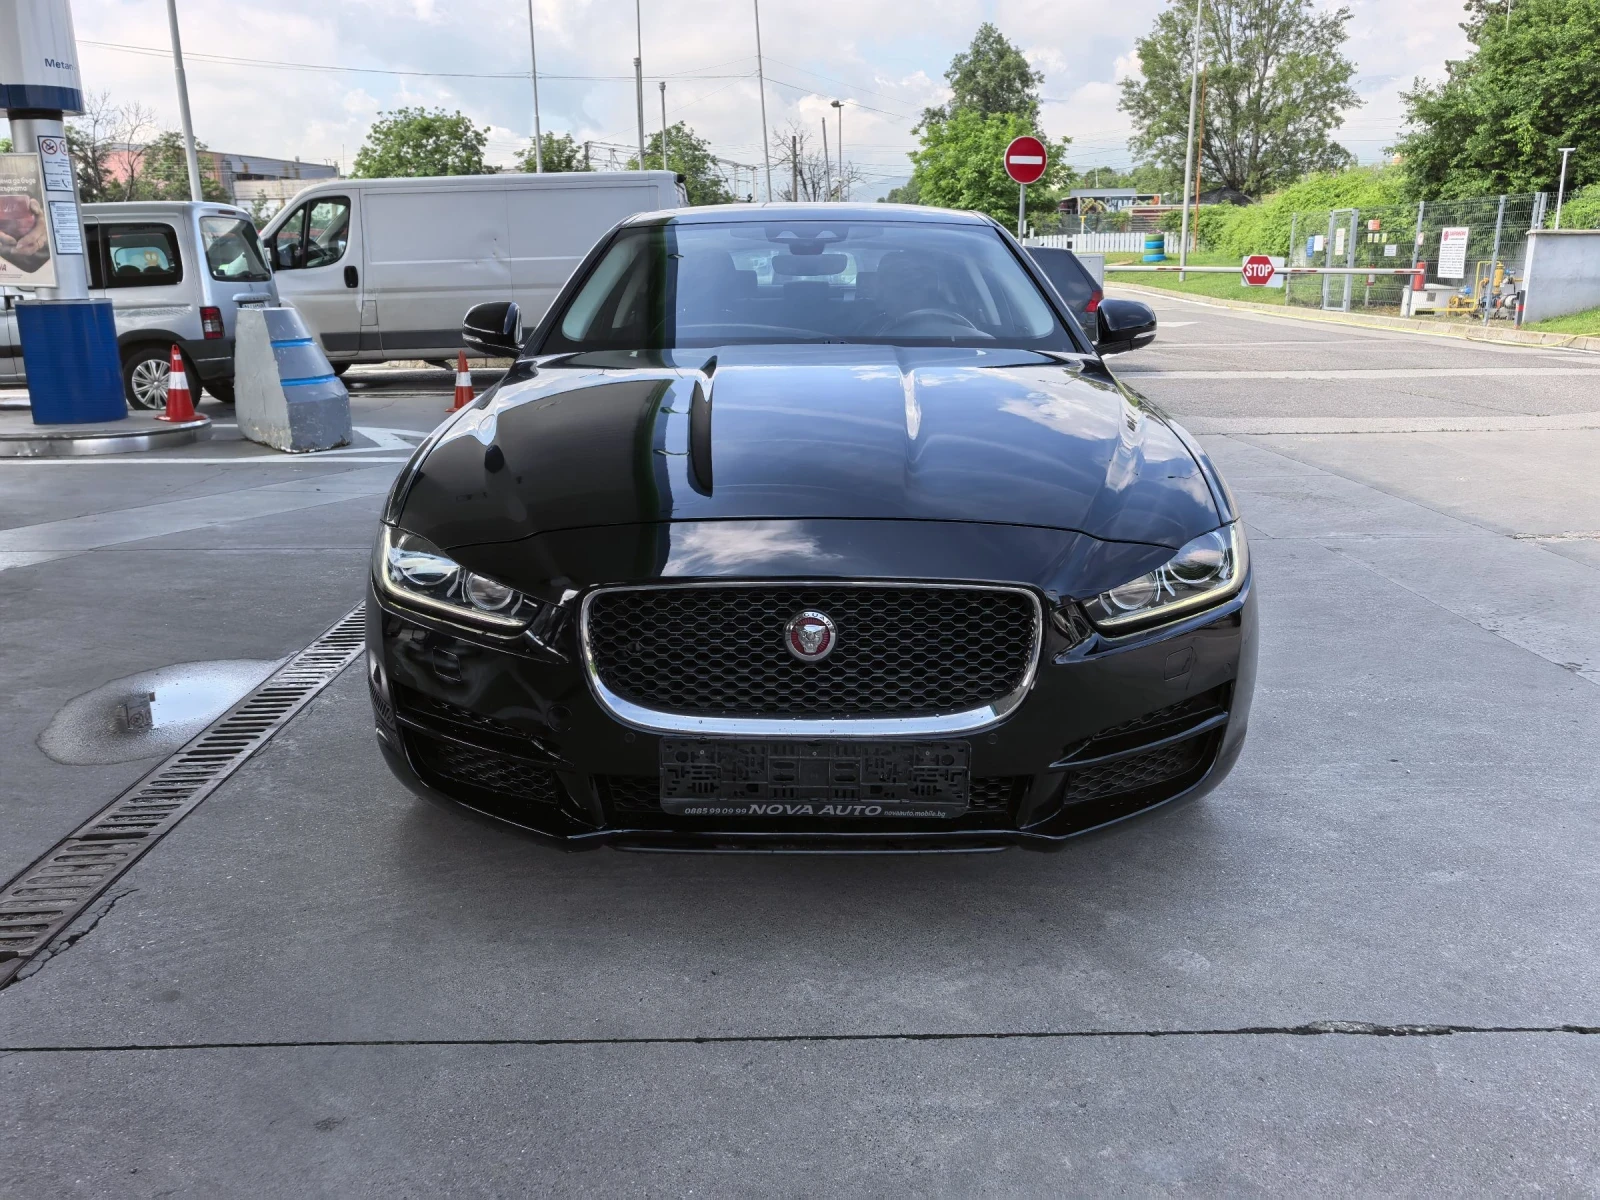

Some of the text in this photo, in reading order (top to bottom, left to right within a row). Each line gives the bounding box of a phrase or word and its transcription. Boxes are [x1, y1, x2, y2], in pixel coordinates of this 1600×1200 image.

[1246, 264, 1271, 276] STOP
[684, 807, 708, 815] 0885
[709, 807, 721, 815] 99
[722, 807, 734, 815] 09
[735, 807, 747, 815] 99
[748, 804, 814, 815] NOVA
[818, 804, 882, 816] AUTO
